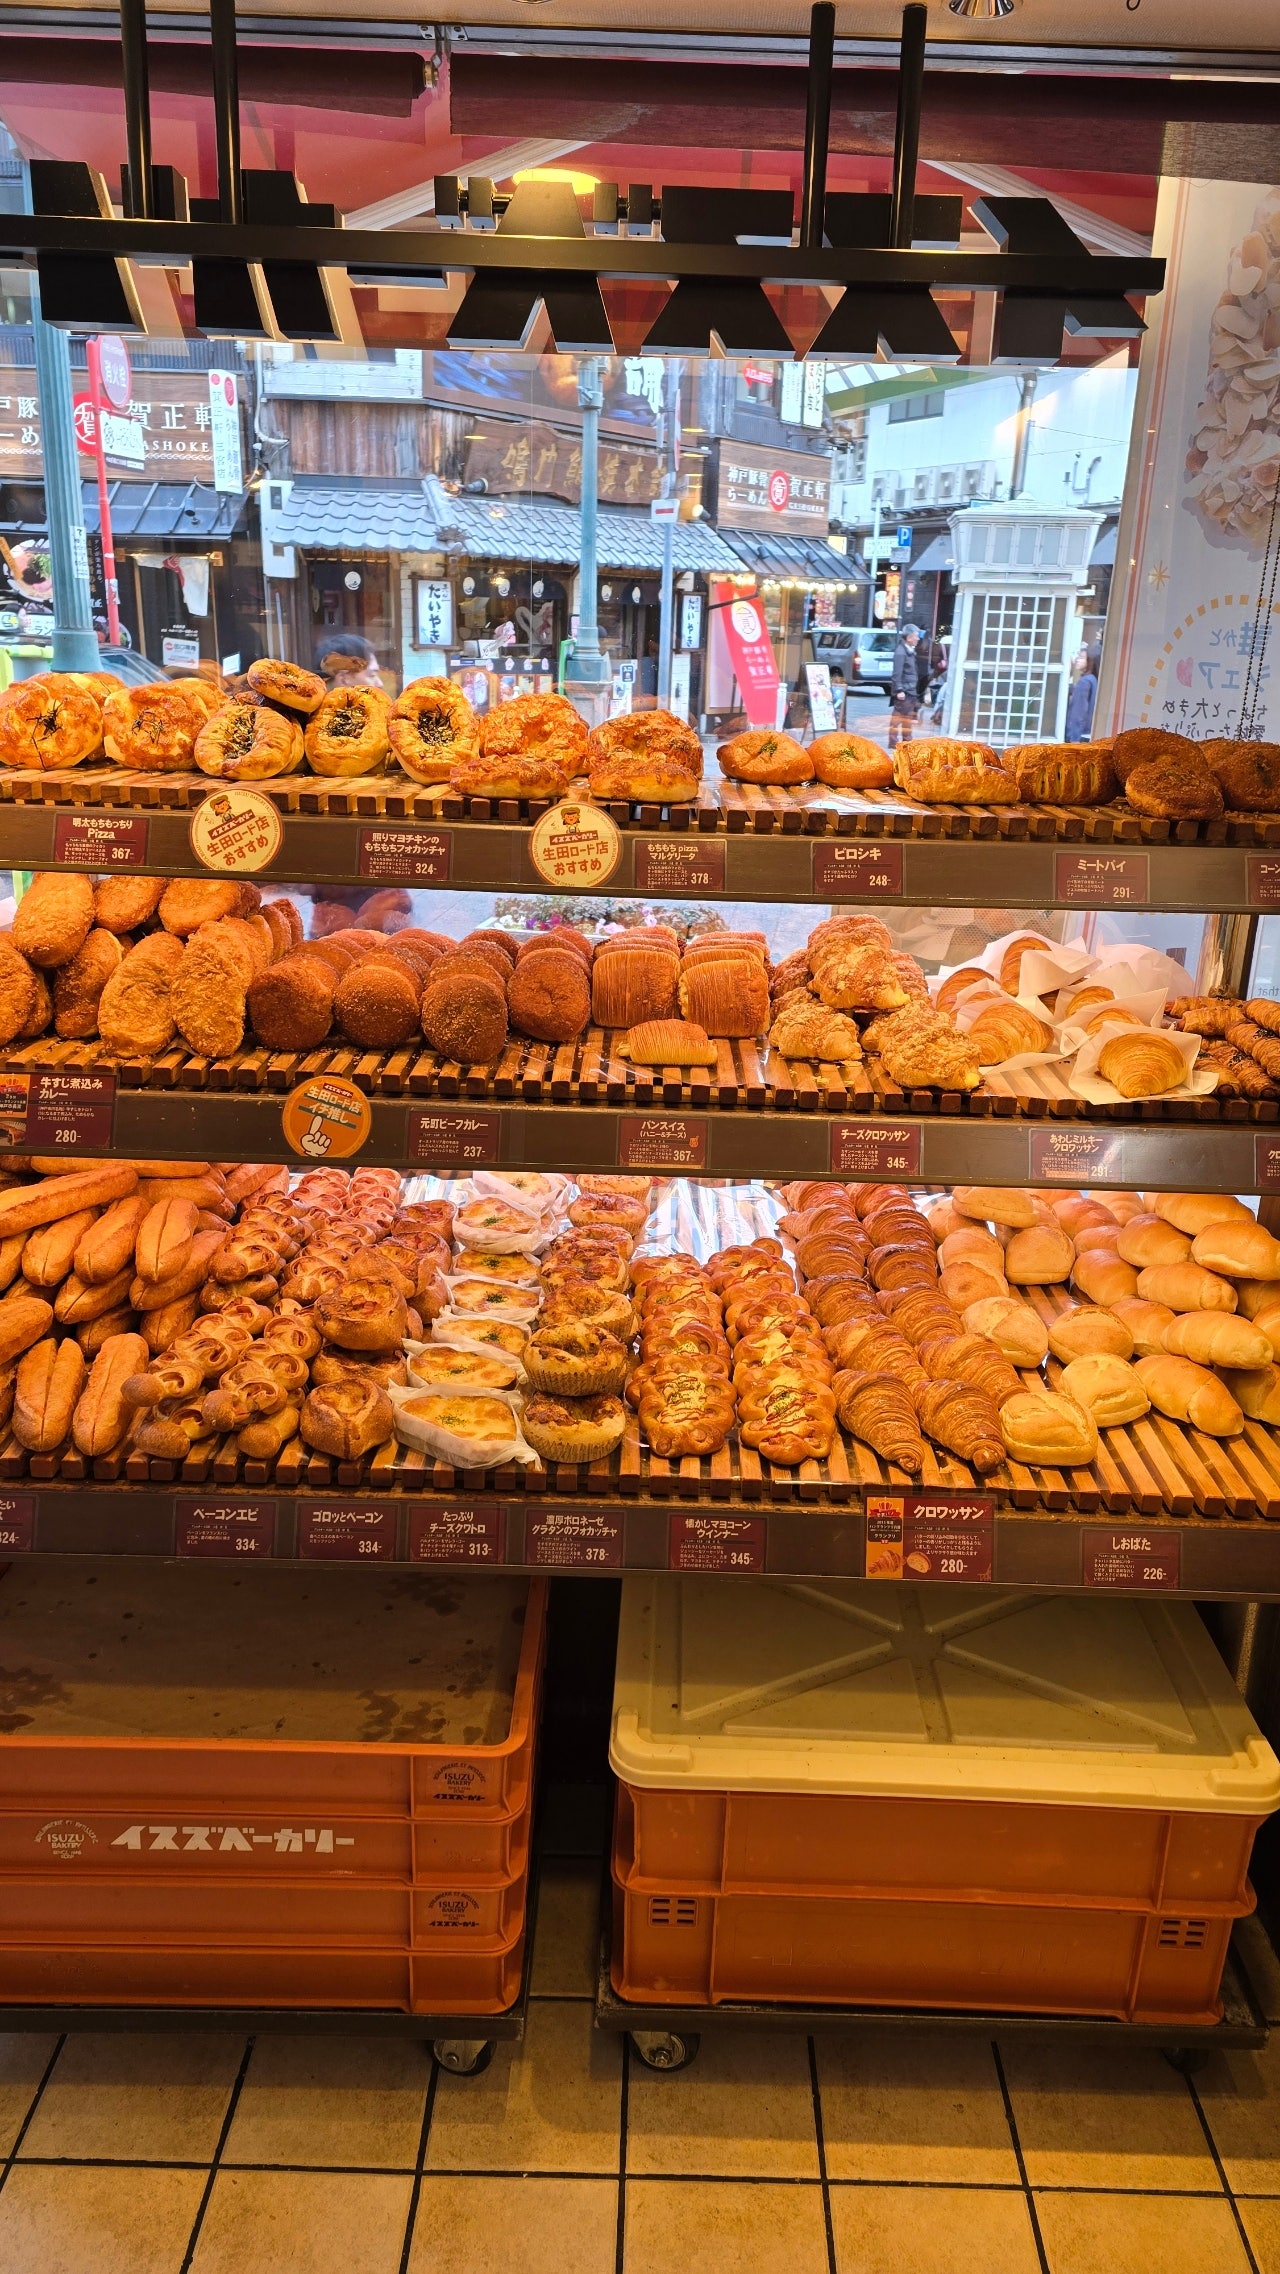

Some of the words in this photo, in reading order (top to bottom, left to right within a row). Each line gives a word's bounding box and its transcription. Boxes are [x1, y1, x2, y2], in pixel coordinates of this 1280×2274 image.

[727, 487, 767, 505] らーめん
[900, 528, 909, 545] P
[428, 584, 442, 644] たいやき
[72, 817, 133, 830] 明太もちもっちり
[87, 828, 116, 839] Pizza
[207, 815, 270, 857] 生田ロード店
[372, 832, 440, 845] 照りマヨチキンの
[223, 834, 269, 866] おすすめ
[364, 842, 446, 856] もちもちフォカッチャ
[542, 841, 609, 861] 生田ロード店
[647, 843, 677, 853] もちもち
[678, 844, 699, 853] pizza
[649, 852, 696, 861] マルゲリータ
[554, 858, 602, 876] おすすめ
[1077, 859, 1127, 873] ミートパイ
[40, 1076, 103, 1090] 牛すじ煮込み
[38, 1088, 69, 1099] カレー
[307, 1085, 362, 1114] 生田ロード店
[309, 1102, 349, 1124] イチ推し
[420, 1117, 489, 1131] 元町ビーフカレー
[641, 1120, 686, 1131] パンスイス
[840, 1128, 911, 1142] チーズクロワッサン
[1049, 1133, 1104, 1145] あわじミルキー
[1053, 1143, 1100, 1153] クロワッサン
[193, 1507, 260, 1522] ベーコンエピ
[312, 1509, 384, 1524] ゴロッとベーコン
[442, 1511, 474, 1522] たっぷり
[913, 1504, 985, 1520] クロワッサン
[545, 1514, 605, 1527] 濃厚ボロネーゼ
[685, 1518, 752, 1530] 懐かしマヨコーン
[429, 1522, 486, 1535] チーズクワトロ
[531, 1524, 618, 1537] グラタンのフォカッチャ
[697, 1528, 739, 1539] ウインナー
[1112, 1536, 1151, 1551] しおばた
[47, 1833, 84, 1842] ISUZU
[110, 1825, 355, 1853] イスズベーカリー
